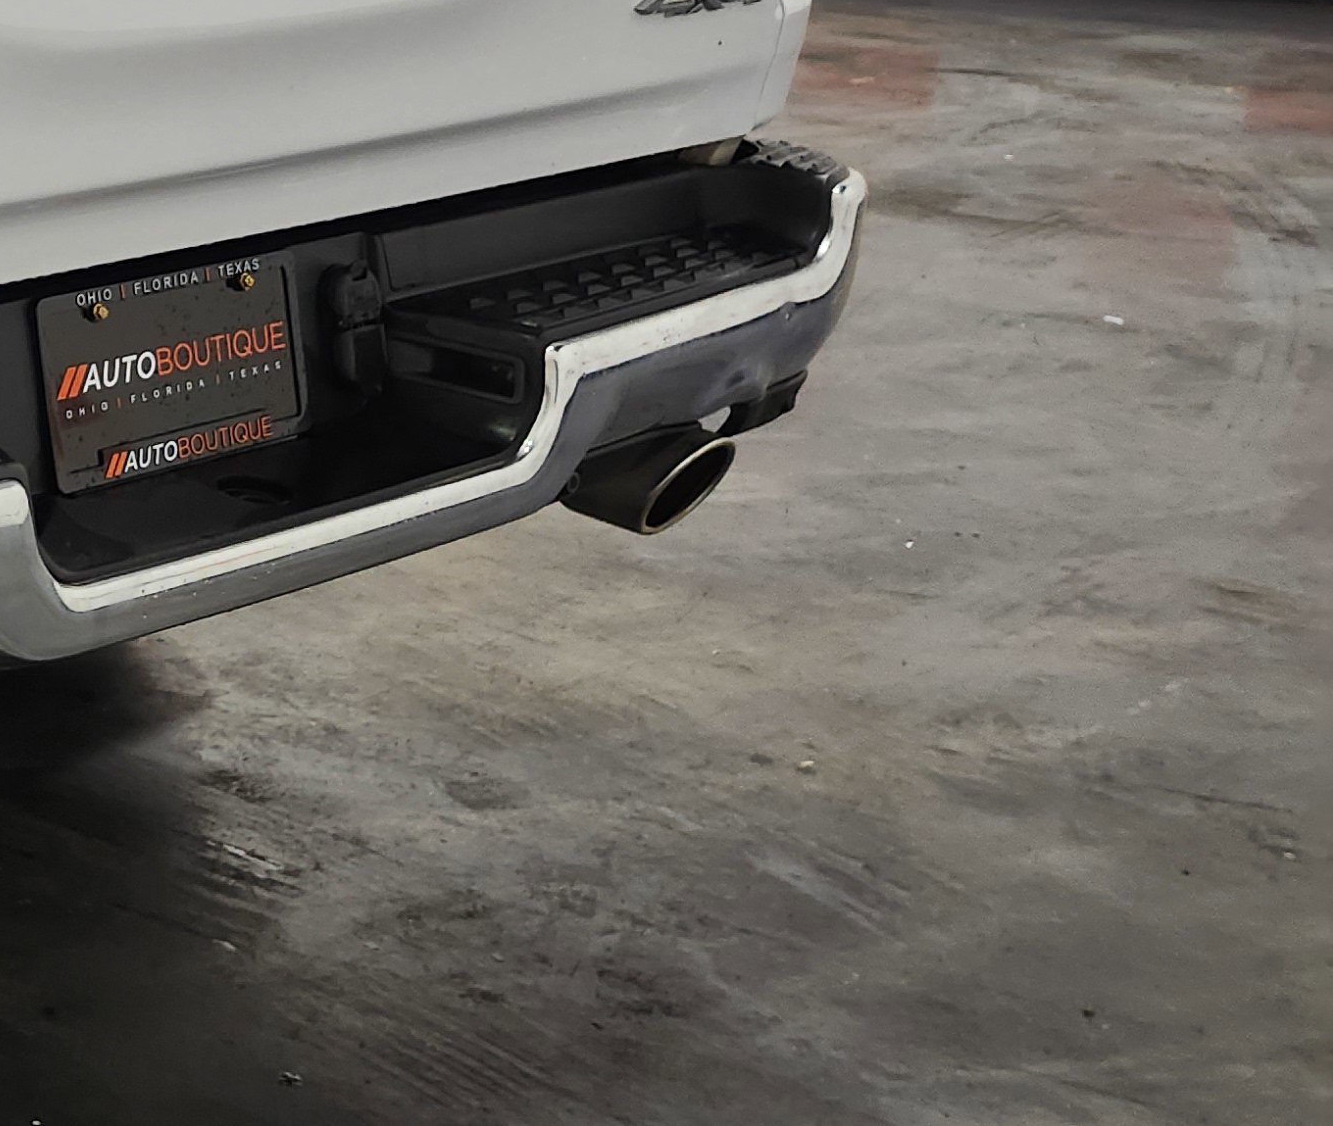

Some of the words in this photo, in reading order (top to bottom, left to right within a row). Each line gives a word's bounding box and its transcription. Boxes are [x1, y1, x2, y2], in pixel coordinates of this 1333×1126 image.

[75, 287, 113, 308] OHIO
[133, 270, 200, 296] FLORIDA
[218, 257, 261, 278] TEXAS
[65, 401, 109, 420] OHIO
[130, 378, 206, 404] FLORIDA
[228, 361, 283, 382] TEXAS
